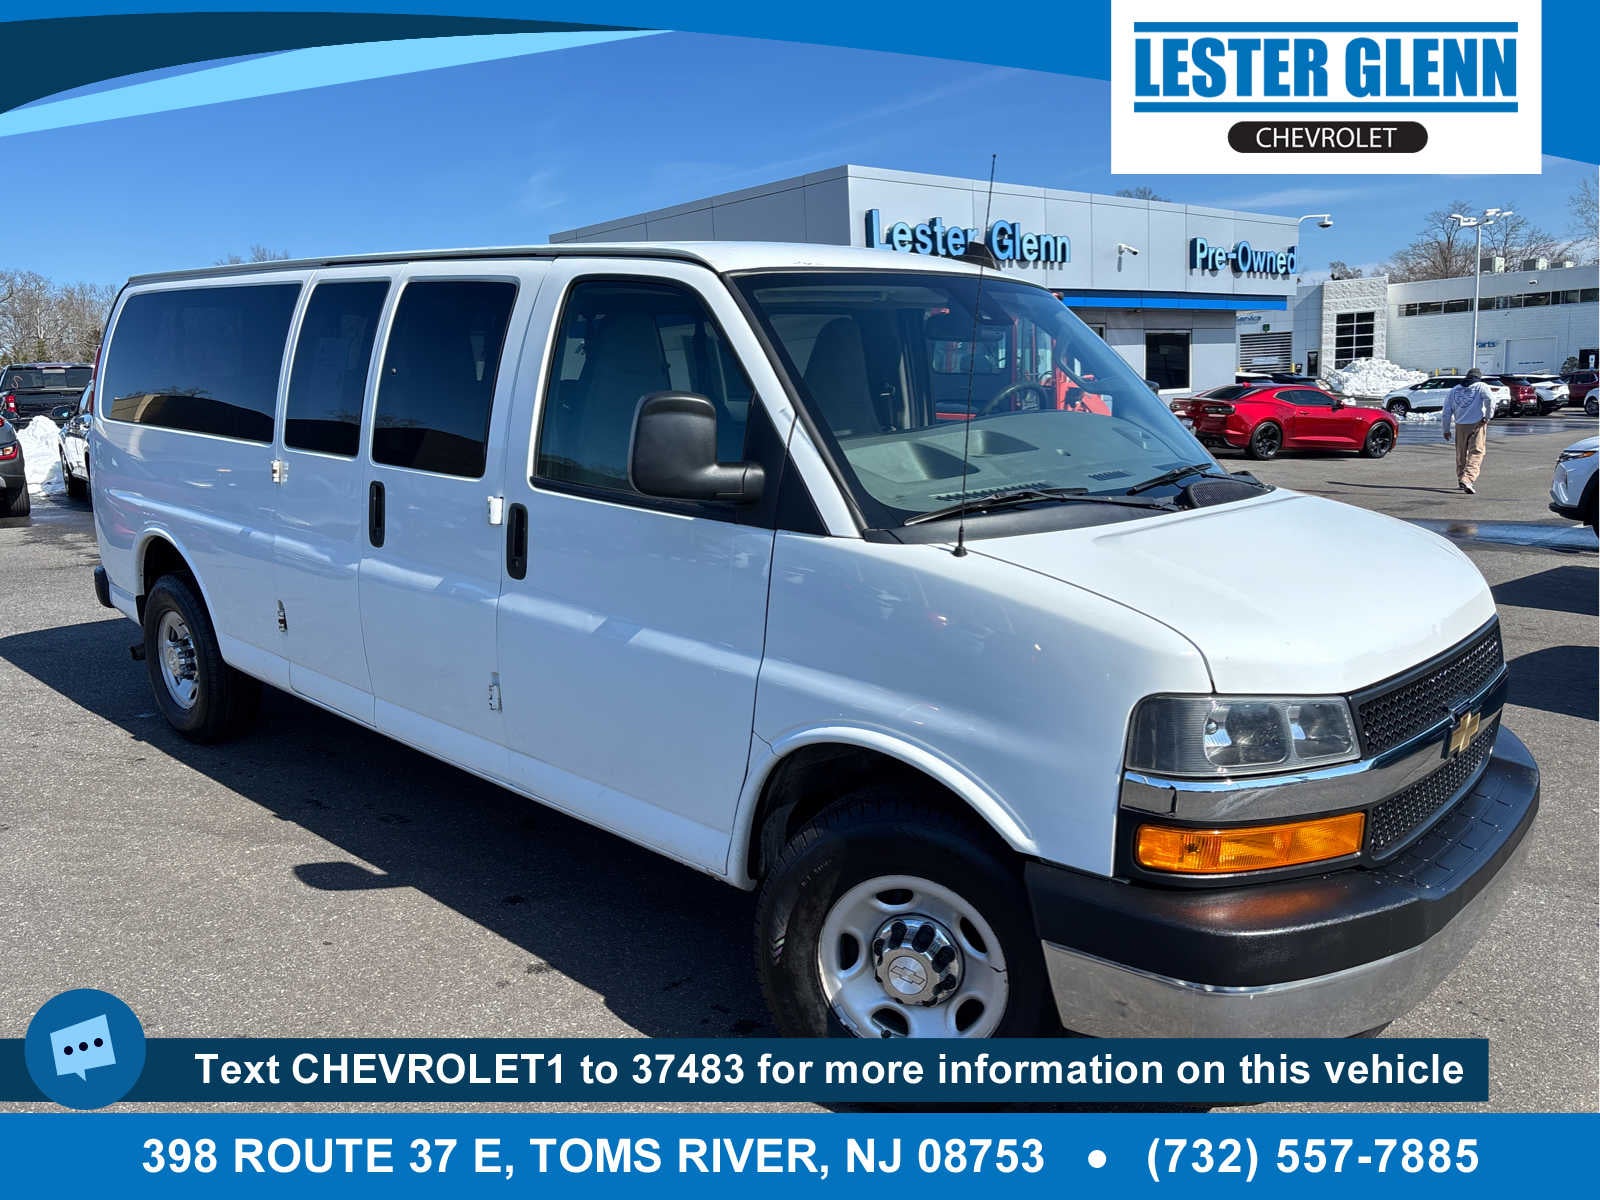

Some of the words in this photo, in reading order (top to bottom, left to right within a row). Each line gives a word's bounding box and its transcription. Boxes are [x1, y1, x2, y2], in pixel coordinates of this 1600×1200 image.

[865, 208, 980, 257] Lester
[985, 219, 1071, 263] Glenn
[1190, 237, 1297, 275] Pre-Owned
